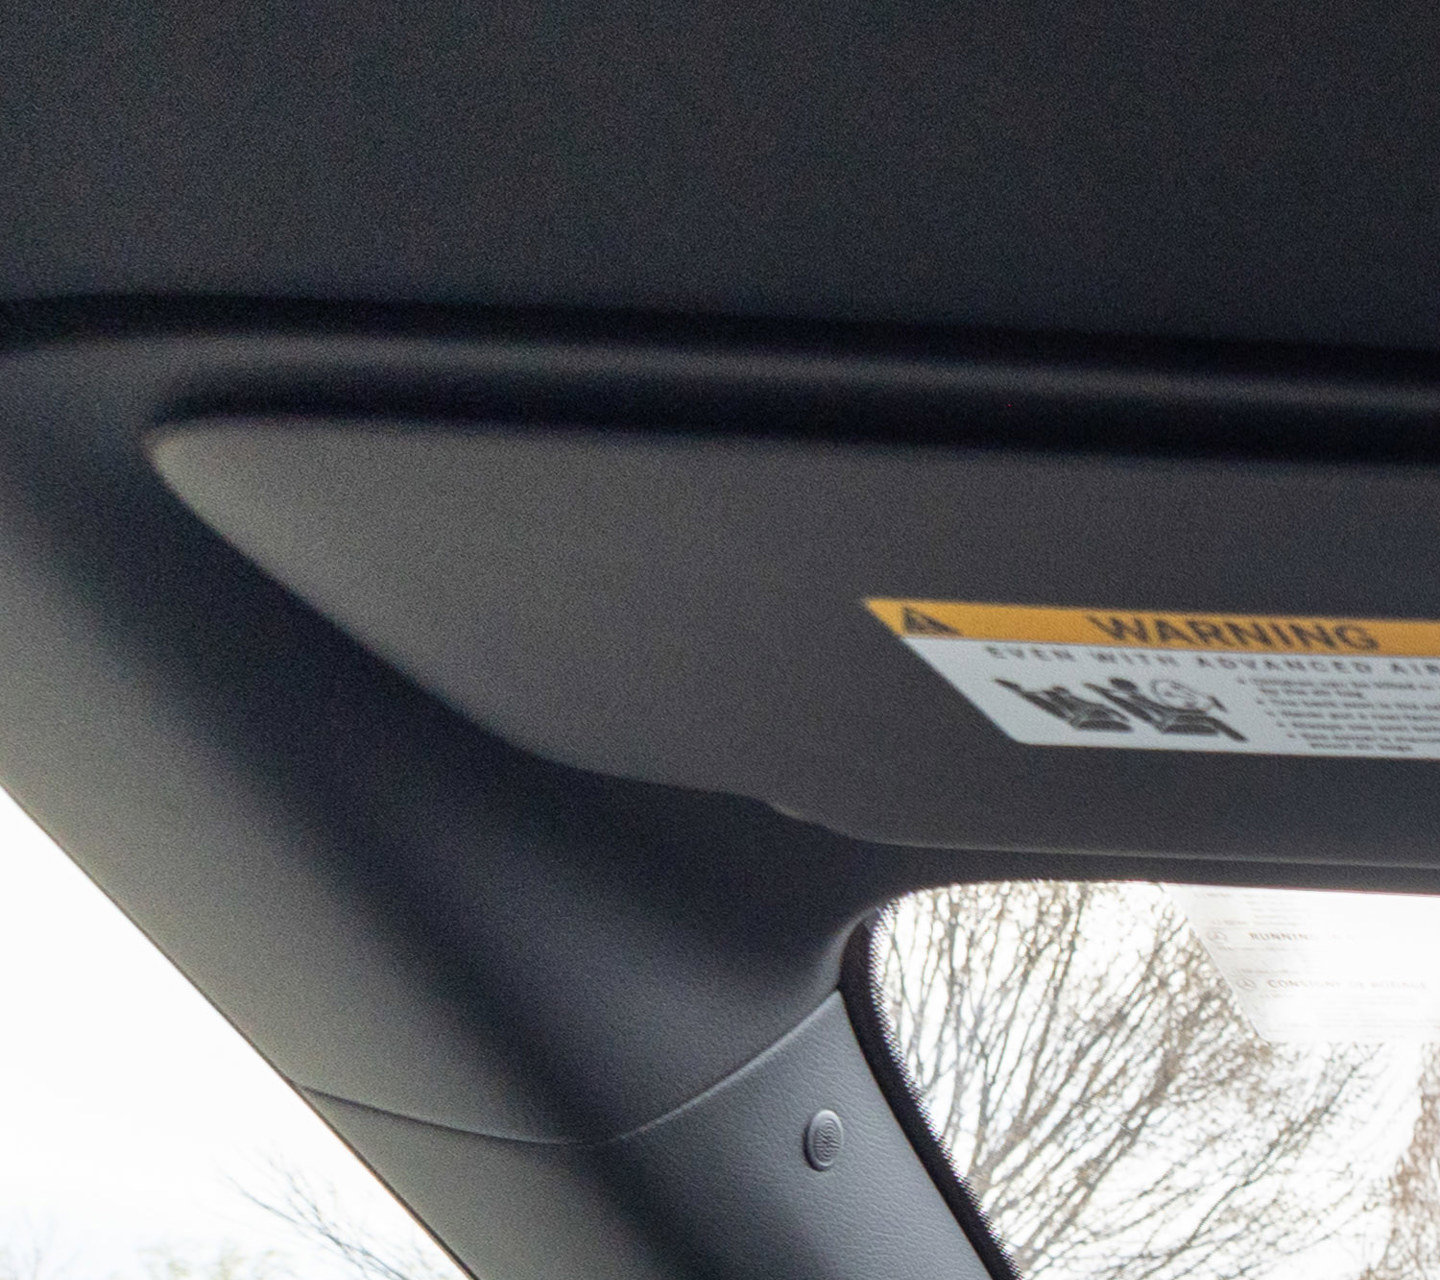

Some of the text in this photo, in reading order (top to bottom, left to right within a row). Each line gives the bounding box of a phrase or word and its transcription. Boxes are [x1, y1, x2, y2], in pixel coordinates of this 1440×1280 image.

[1087, 616, 1382, 652] WARNING
[986, 646, 1075, 661] EVEN
[1094, 652, 1179, 666] WITH
[1196, 656, 1372, 673] ADVANCED
